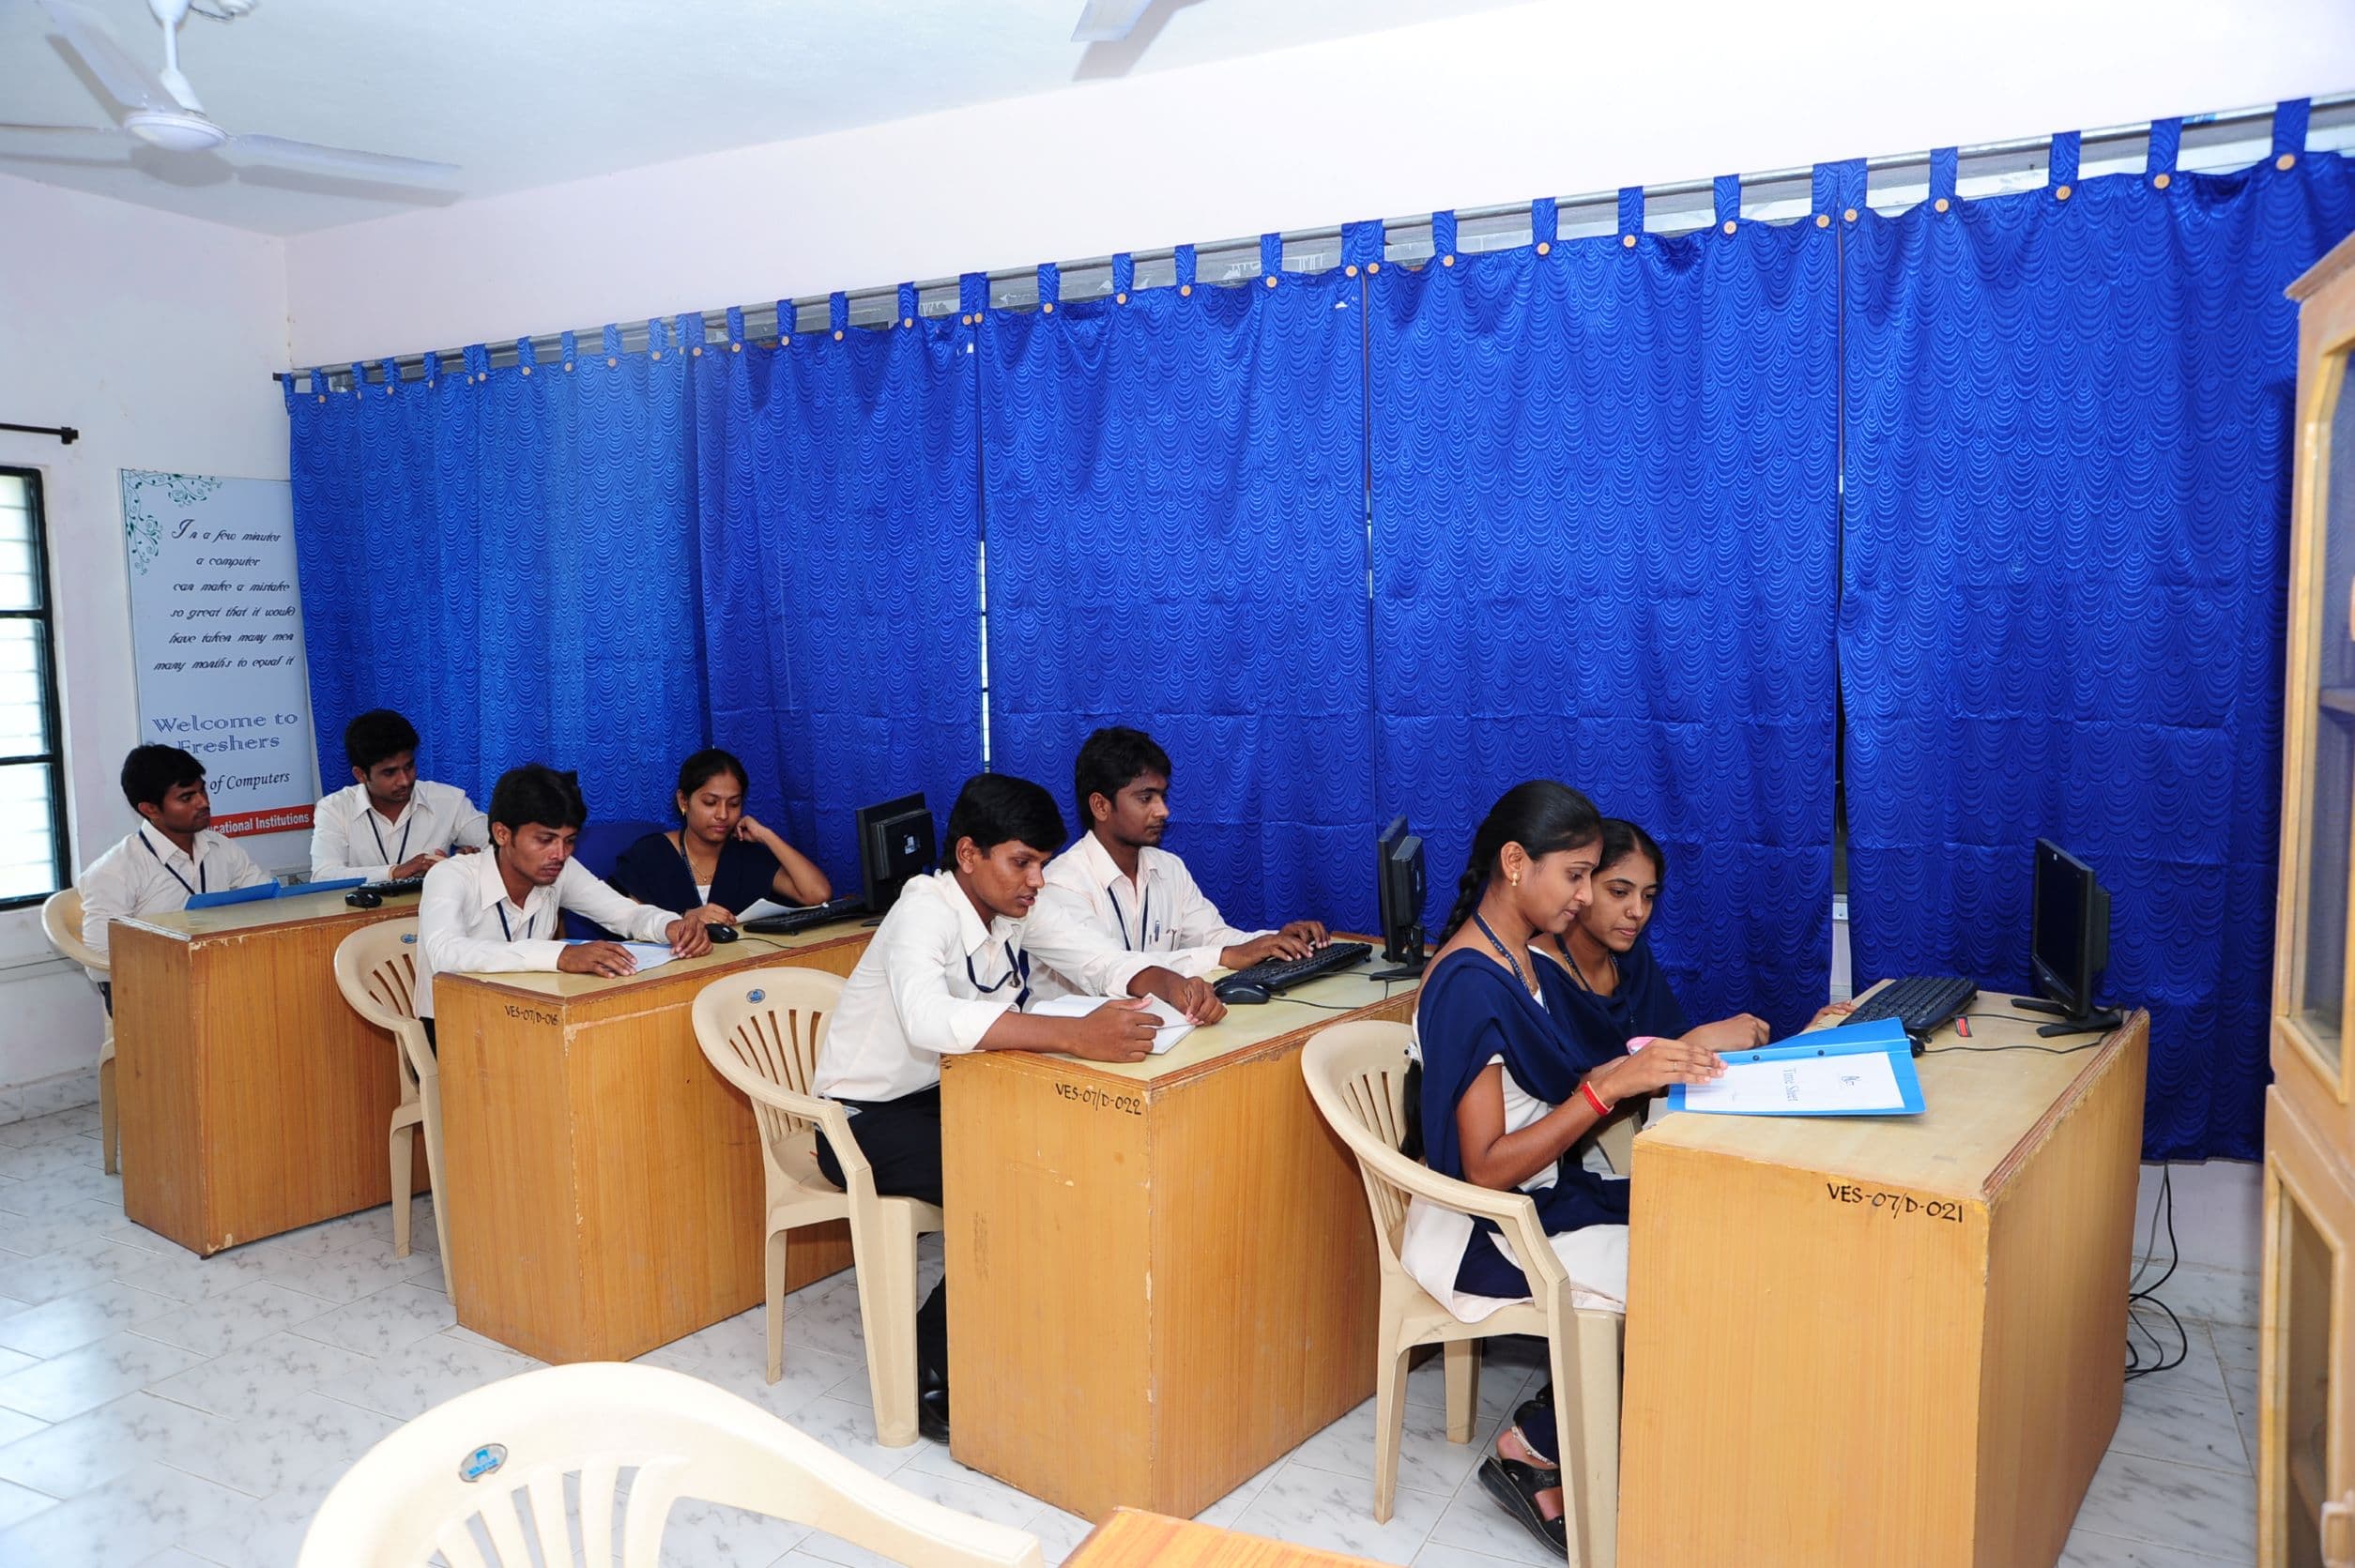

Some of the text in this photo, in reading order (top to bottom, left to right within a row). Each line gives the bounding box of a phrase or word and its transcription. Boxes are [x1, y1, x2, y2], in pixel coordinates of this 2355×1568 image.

[203, 531, 211, 540] a
[212, 529, 236, 543] few
[241, 531, 281, 542] minutes
[196, 556, 261, 568] a computer
[173, 580, 290, 592] can make a mistake
[170, 605, 296, 620] so great that it would
[169, 632, 294, 645] have taken many men
[153, 655, 296, 673] many months to equal it
[152, 712, 298, 734] Welcome to
[177, 735, 280, 754] Freshers
[209, 771, 290, 795] of Computers
[255, 813, 310, 828] Institutions
[1055, 1082, 1142, 1116] VES-07/D-022
[1826, 1182, 1963, 1224] VES-07/D-021
